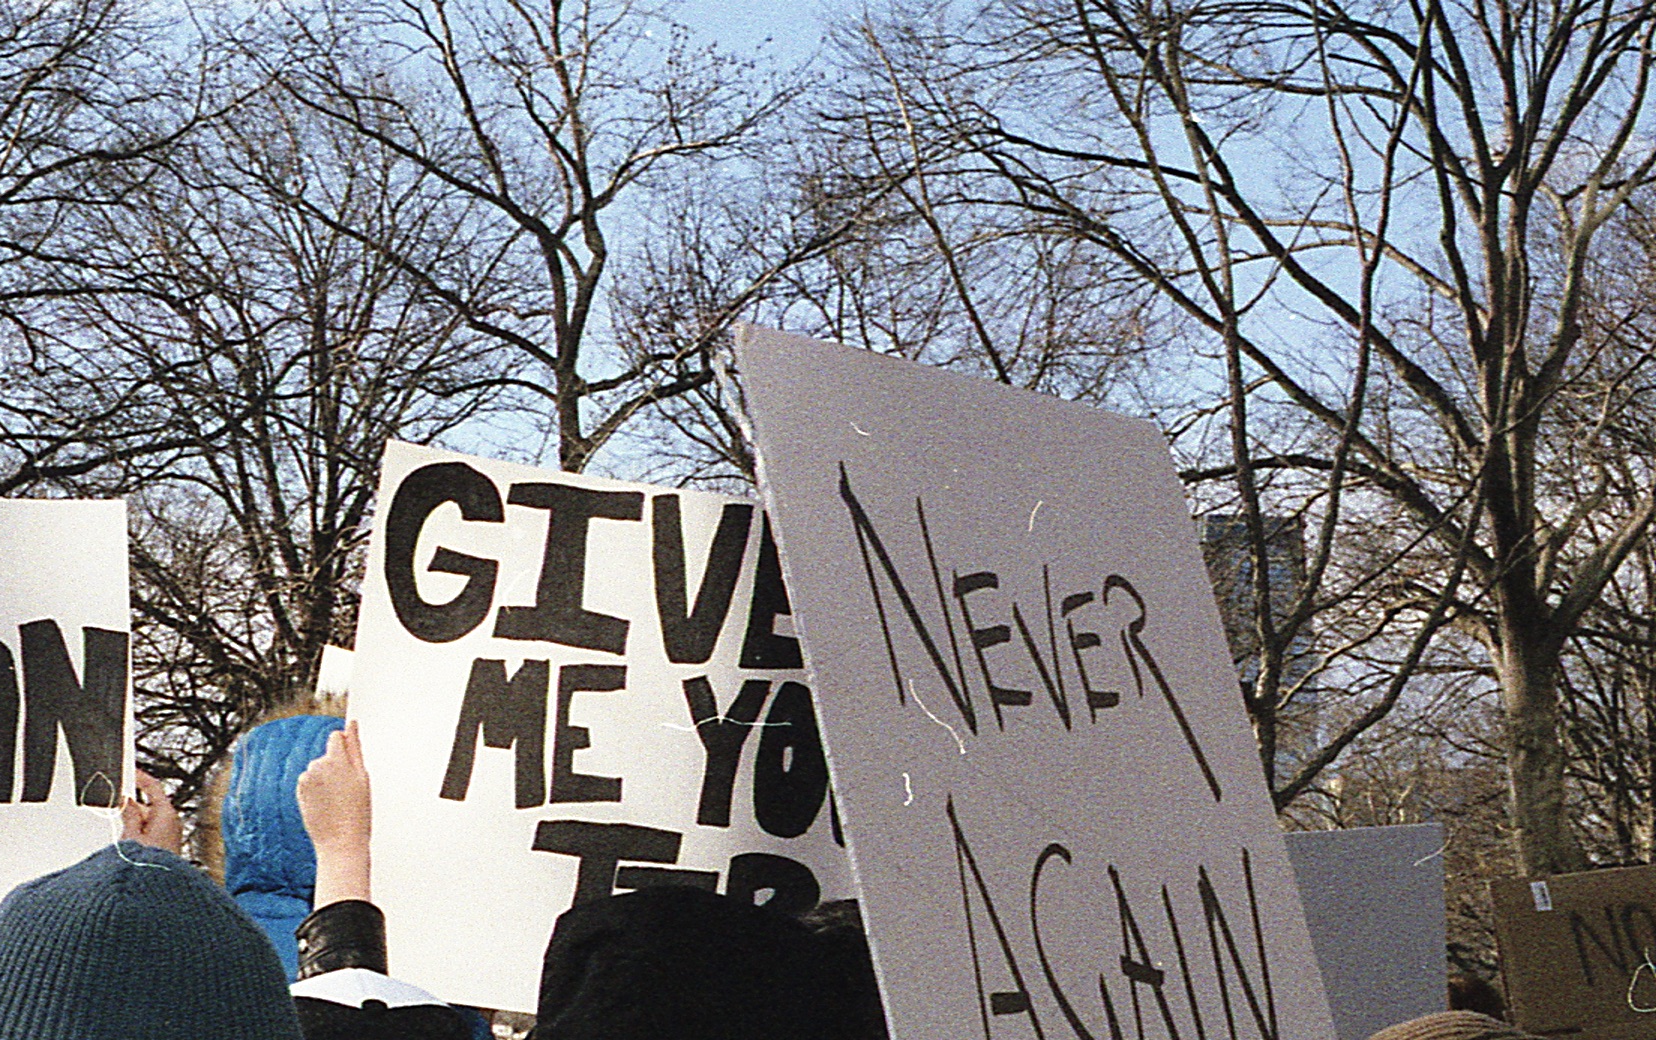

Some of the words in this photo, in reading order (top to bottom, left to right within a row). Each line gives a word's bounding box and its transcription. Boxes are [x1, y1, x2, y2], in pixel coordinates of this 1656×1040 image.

[439, 657, 628, 809] ME
[682, 674, 846, 848] YO
[839, 460, 1222, 802] NEVER
